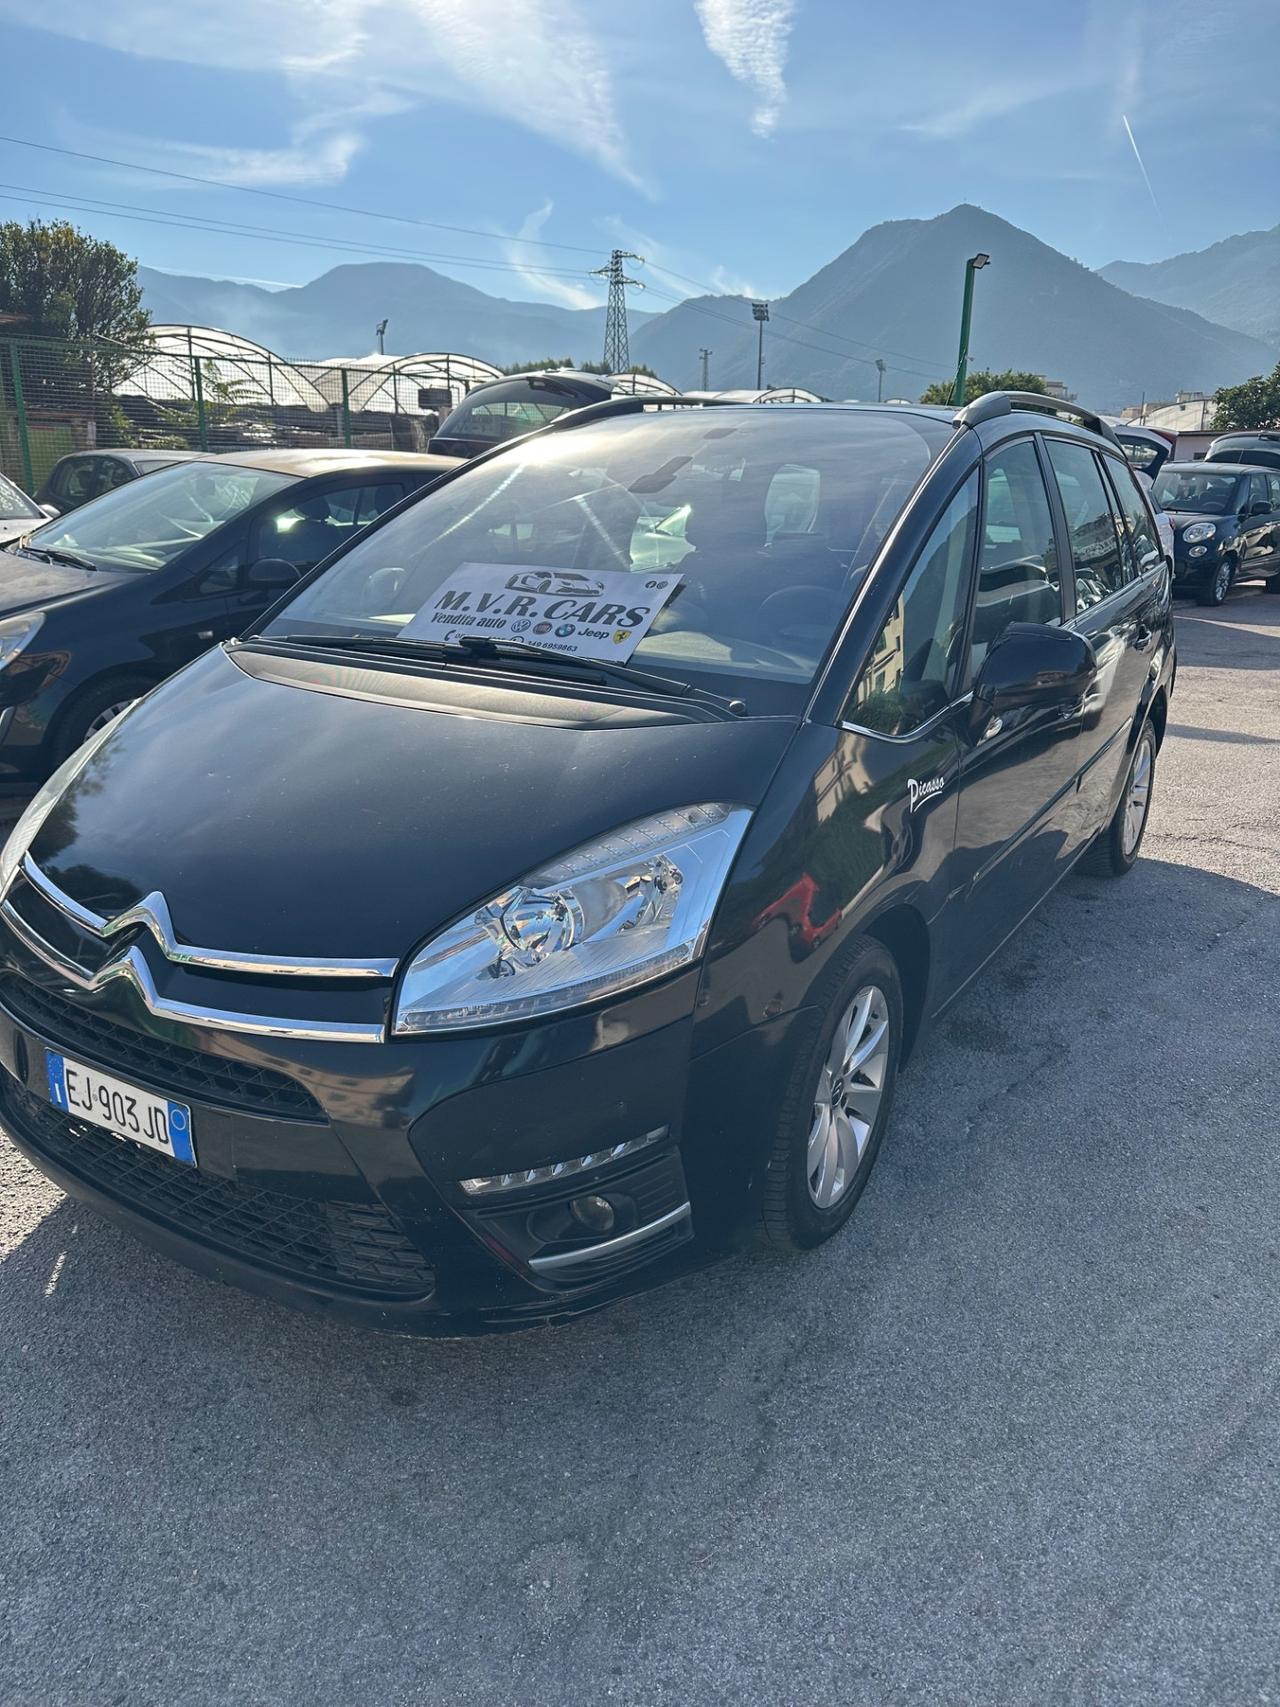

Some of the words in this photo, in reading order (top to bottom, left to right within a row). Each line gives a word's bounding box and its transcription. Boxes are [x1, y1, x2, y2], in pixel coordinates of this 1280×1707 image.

[431, 612, 477, 626] Vendita
[476, 617, 507, 629] auto
[434, 590, 539, 618] M.V.R.
[543, 599, 652, 628] CARS
[577, 628, 610, 640] Jeep
[907, 776, 945, 814] Picasso
